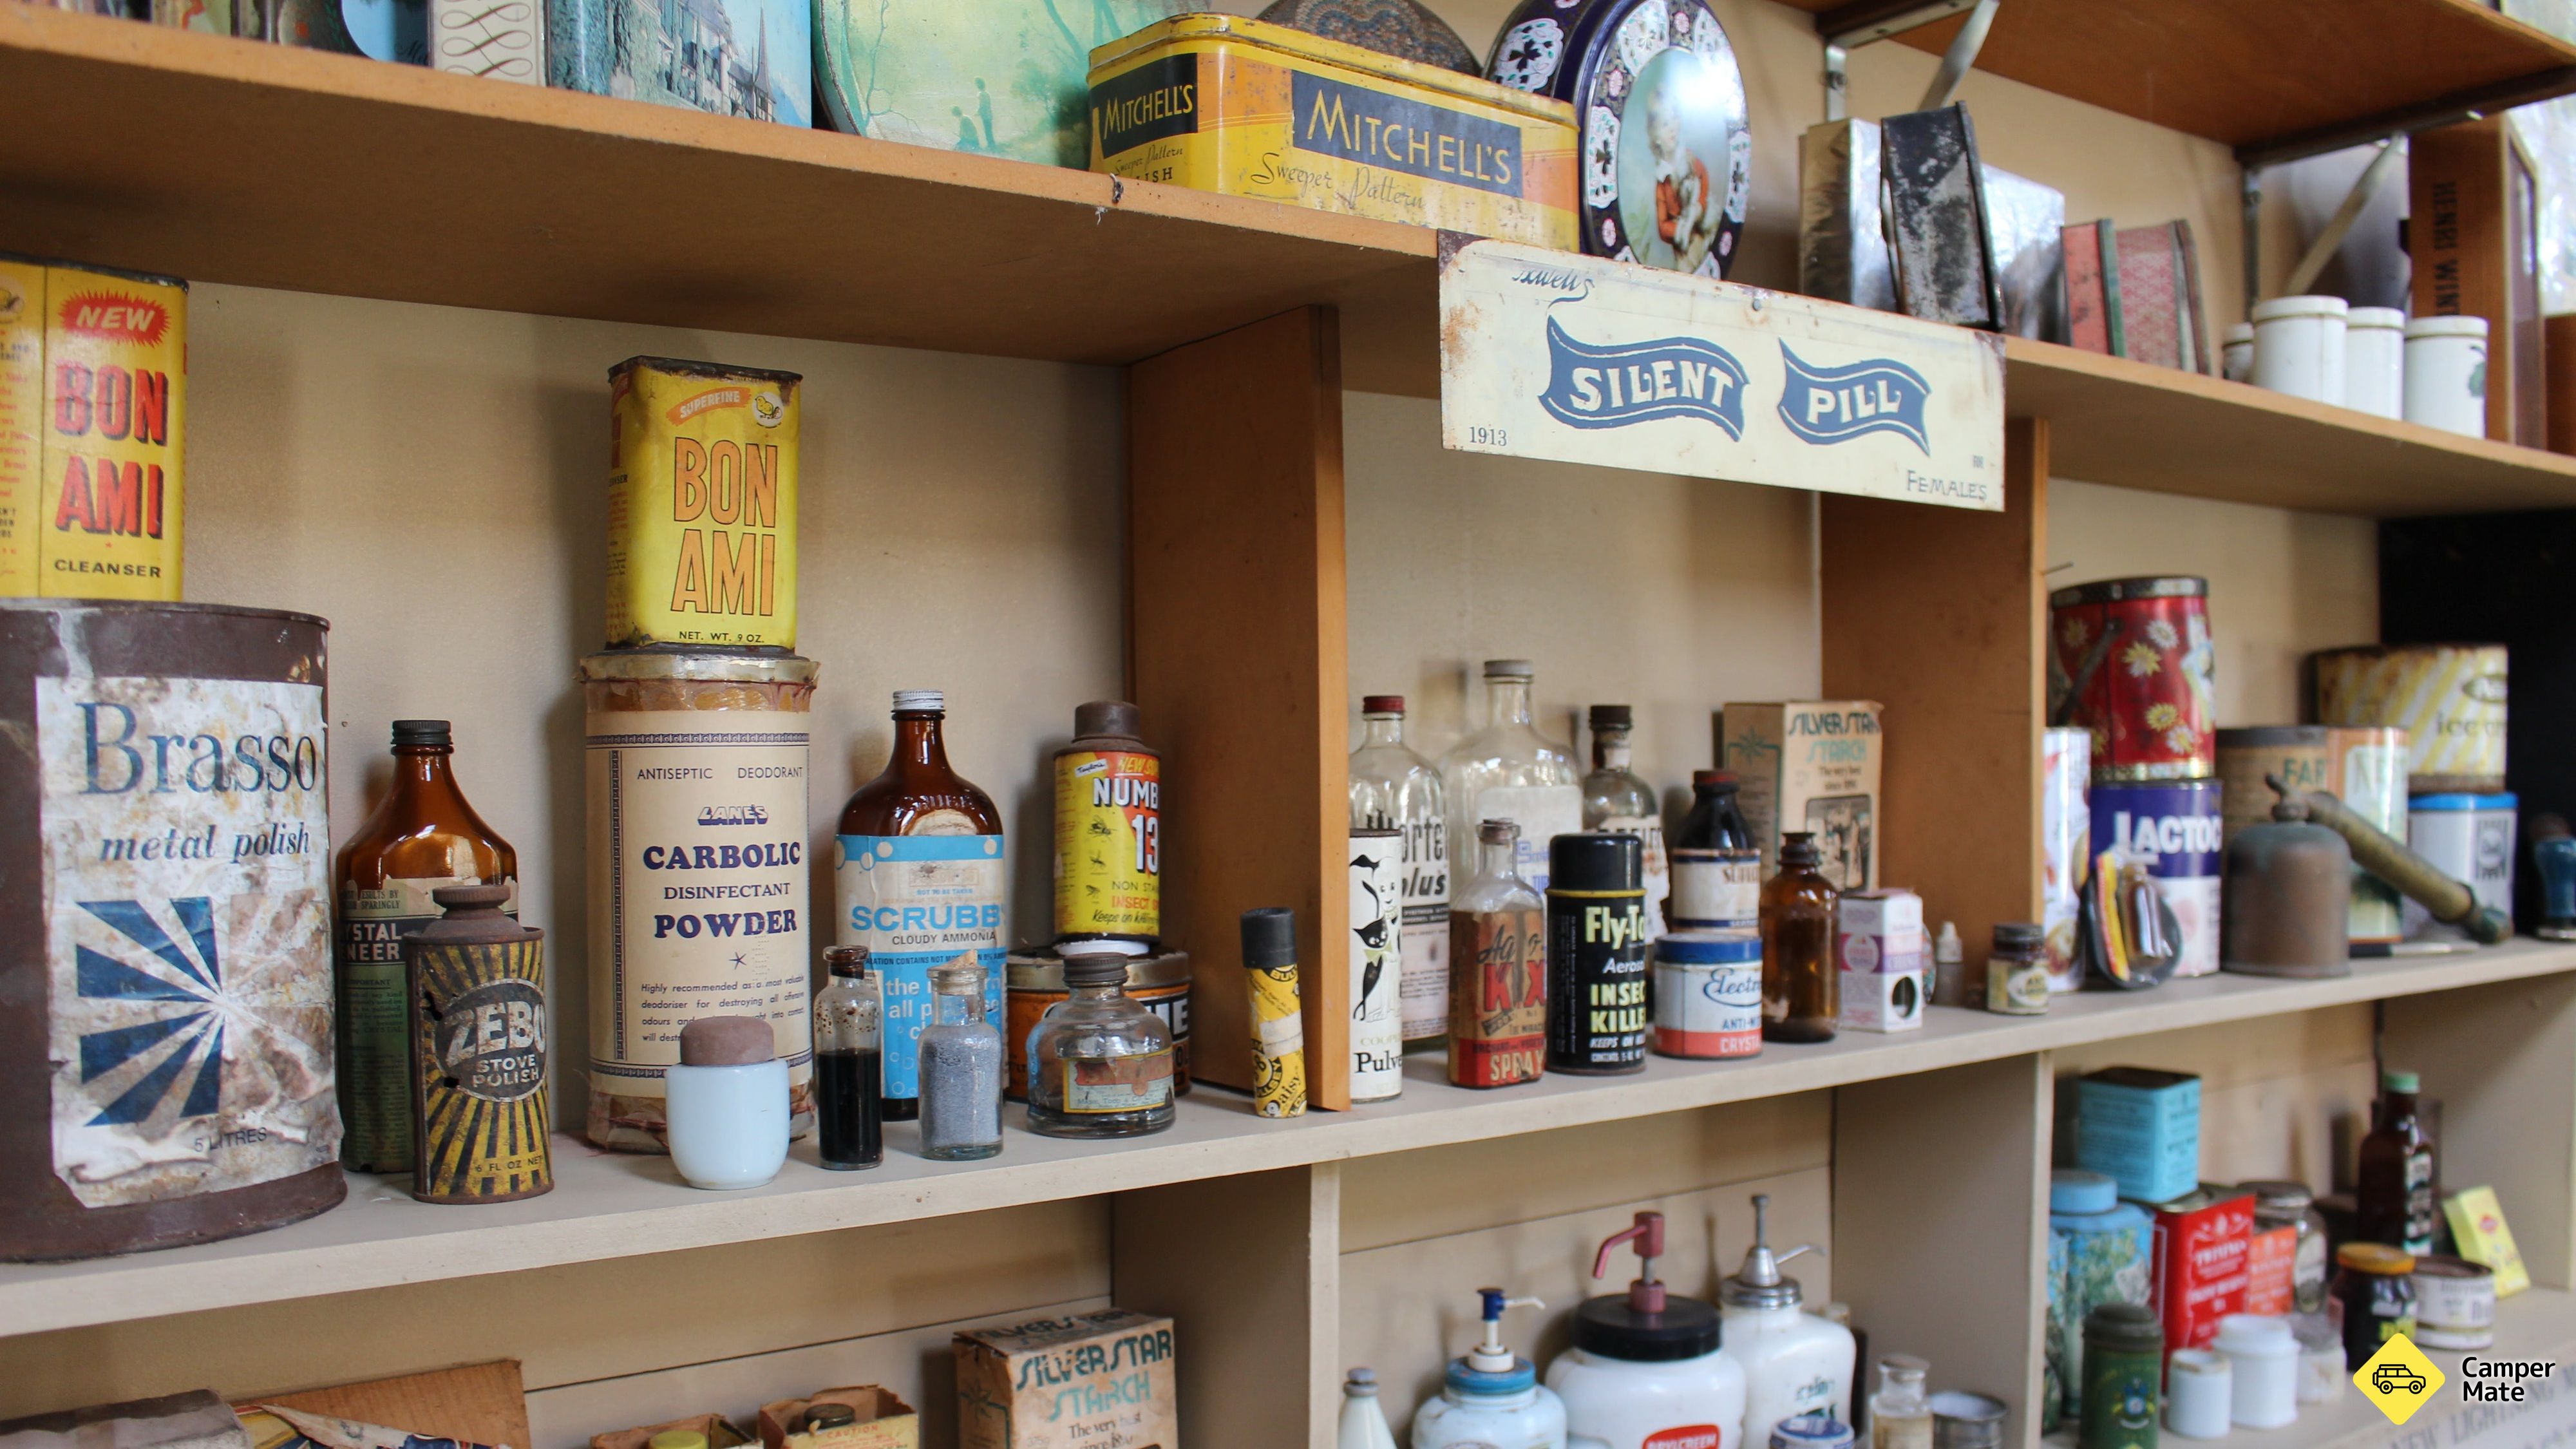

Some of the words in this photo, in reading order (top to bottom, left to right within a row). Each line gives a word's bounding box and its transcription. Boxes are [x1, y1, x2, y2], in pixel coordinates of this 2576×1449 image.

[1103, 84, 1194, 140] MITCHELL'S
[1307, 88, 1512, 185] MITCHELL'S
[1250, 152, 1333, 195] Sweeper
[1340, 166, 1425, 208] Pattern
[75, 305, 155, 332] NEW
[54, 358, 168, 446] BON
[1569, 359, 1734, 413] SILENT
[1806, 379, 1902, 425] PILL
[680, 390, 740, 419] SUPERFINE
[1468, 426, 1508, 447] 1913
[674, 437, 778, 529] BON
[1906, 469, 1988, 500] FEMALES
[55, 455, 164, 540] AMI
[54, 559, 162, 578] CLEANSER
[670, 528, 776, 617] AMI
[679, 630, 703, 641] NET.
[710, 632, 732, 642] WT.
[737, 634, 743, 643] 9
[746, 634, 765, 643] OZ.
[75, 702, 317, 795] Brasso
[637, 768, 714, 780] ANTISEPTIC
[737, 766, 803, 779] DEODORANT
[1093, 777, 1159, 810] NUMB
[697, 804, 769, 826] LANE'S
[99, 824, 216, 861] metal
[230, 821, 310, 864] polish
[643, 841, 800, 870] CARBOLIC
[663, 882, 791, 900] DISINFECTANT
[1112, 880, 1139, 891] NON
[654, 909, 797, 939] POWDER
[1092, 909, 1120, 925] Keeps
[892, 934, 938, 945] CLOUDY
[942, 931, 996, 943] AMMONIA
[346, 943, 400, 961] NEER
[895, 956, 929, 965] CONTAINS
[641, 983, 668, 994] Highly
[673, 981, 738, 992] recommended
[886, 978, 920, 996] the
[641, 1000, 688, 1009] deodoriser
[696, 999, 710, 1009] for
[719, 998, 763, 1008] destroying
[770, 994, 779, 1003] all
[888, 999, 913, 1018] all
[446, 1000, 546, 1066] ZEBO
[641, 1018, 670, 1026] odours
[642, 1033, 656, 1042] will
[659, 1033, 681, 1042] destr
[476, 1054, 536, 1073] STOVE
[1489, 1049, 1545, 1083] SPRAY
[472, 1067, 540, 1088] POLISH
[194, 1137, 205, 1153] 5
[209, 1127, 267, 1151] LITRES
[489, 1162, 501, 1172] FL
[507, 1159, 522, 1169] OZ
[527, 1155, 543, 1166] NET
[1016, 1345, 1107, 1392] SILVER
[1110, 1329, 1173, 1372] STAR
[1048, 1370, 1152, 1423] STARCH
[826, 1425, 880, 1439] CAUTION
[1068, 1423, 1092, 1439] The
